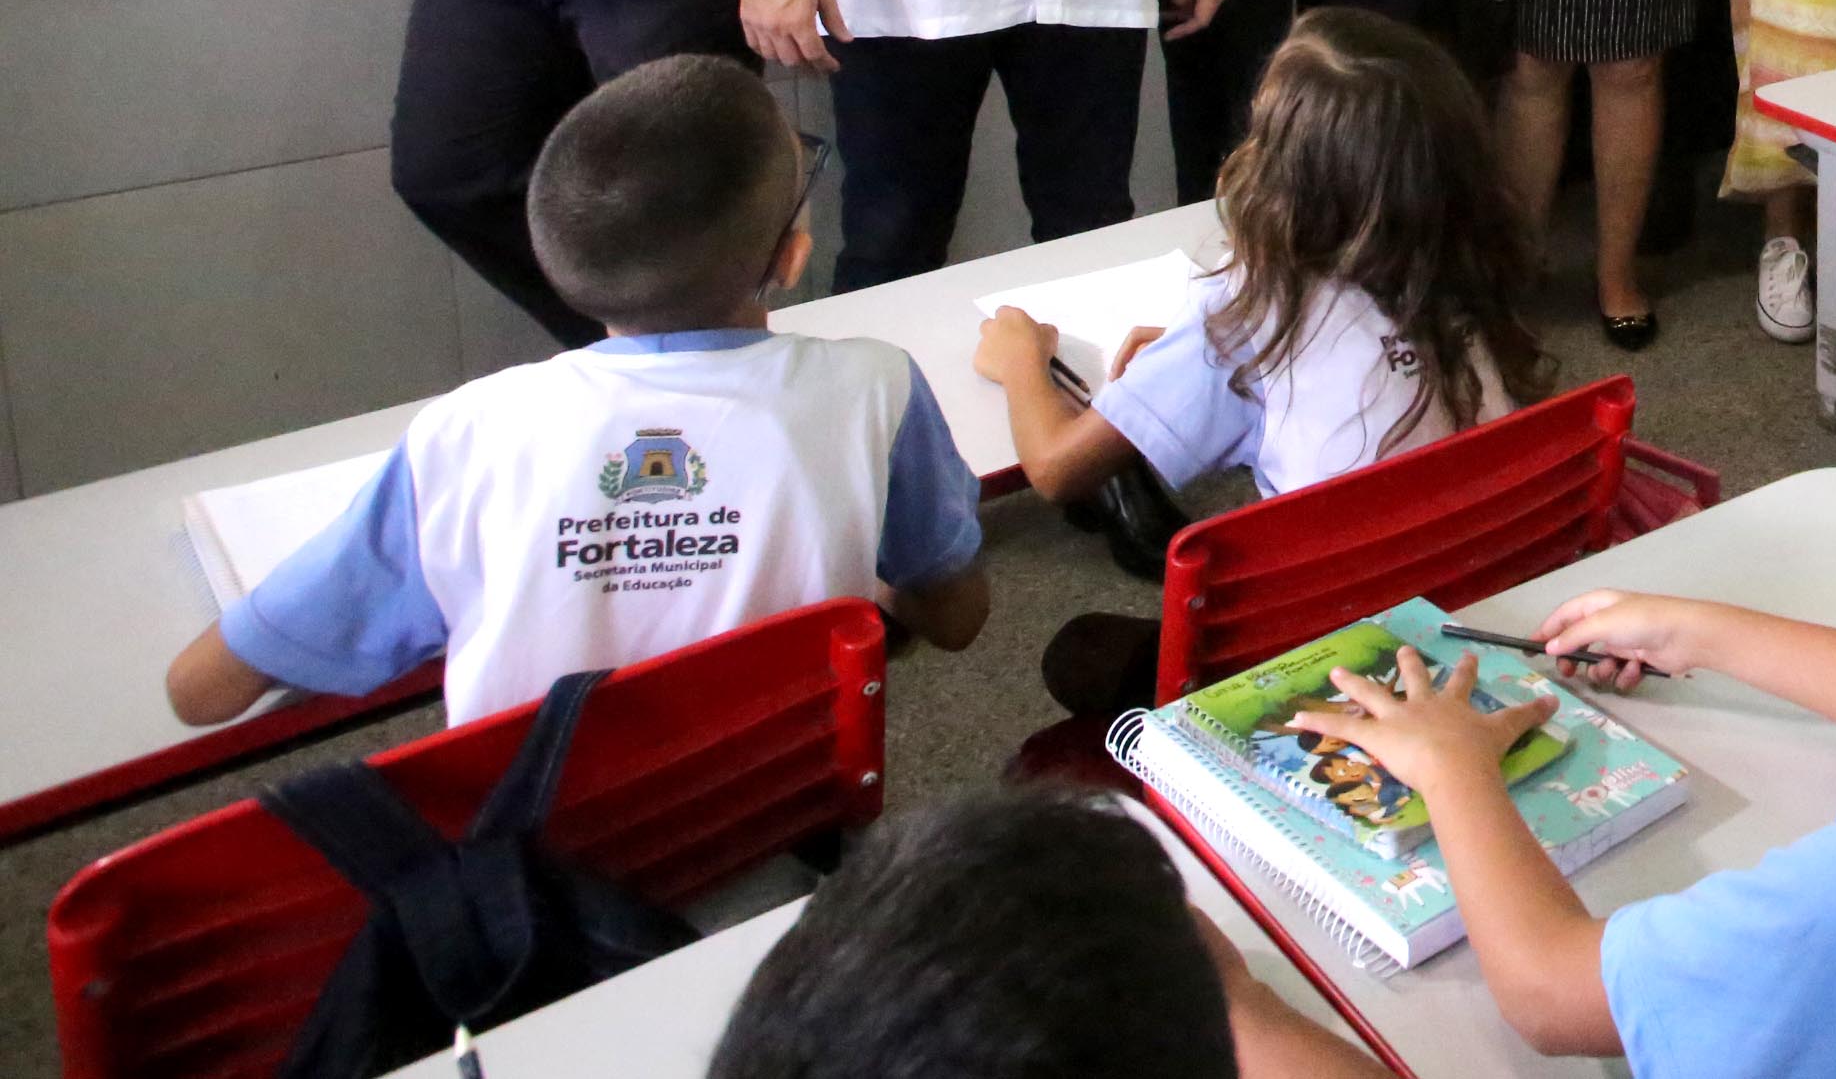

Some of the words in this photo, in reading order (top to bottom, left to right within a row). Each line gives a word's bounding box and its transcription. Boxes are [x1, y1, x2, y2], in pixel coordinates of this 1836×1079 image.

[557, 509, 699, 536] Prefeitura
[708, 506, 741, 524] de
[556, 529, 740, 568] Fortaleza
[573, 562, 647, 582] Secretaria
[651, 559, 723, 573] Municipal
[602, 580, 619, 594] da
[622, 576, 693, 592] Educação
